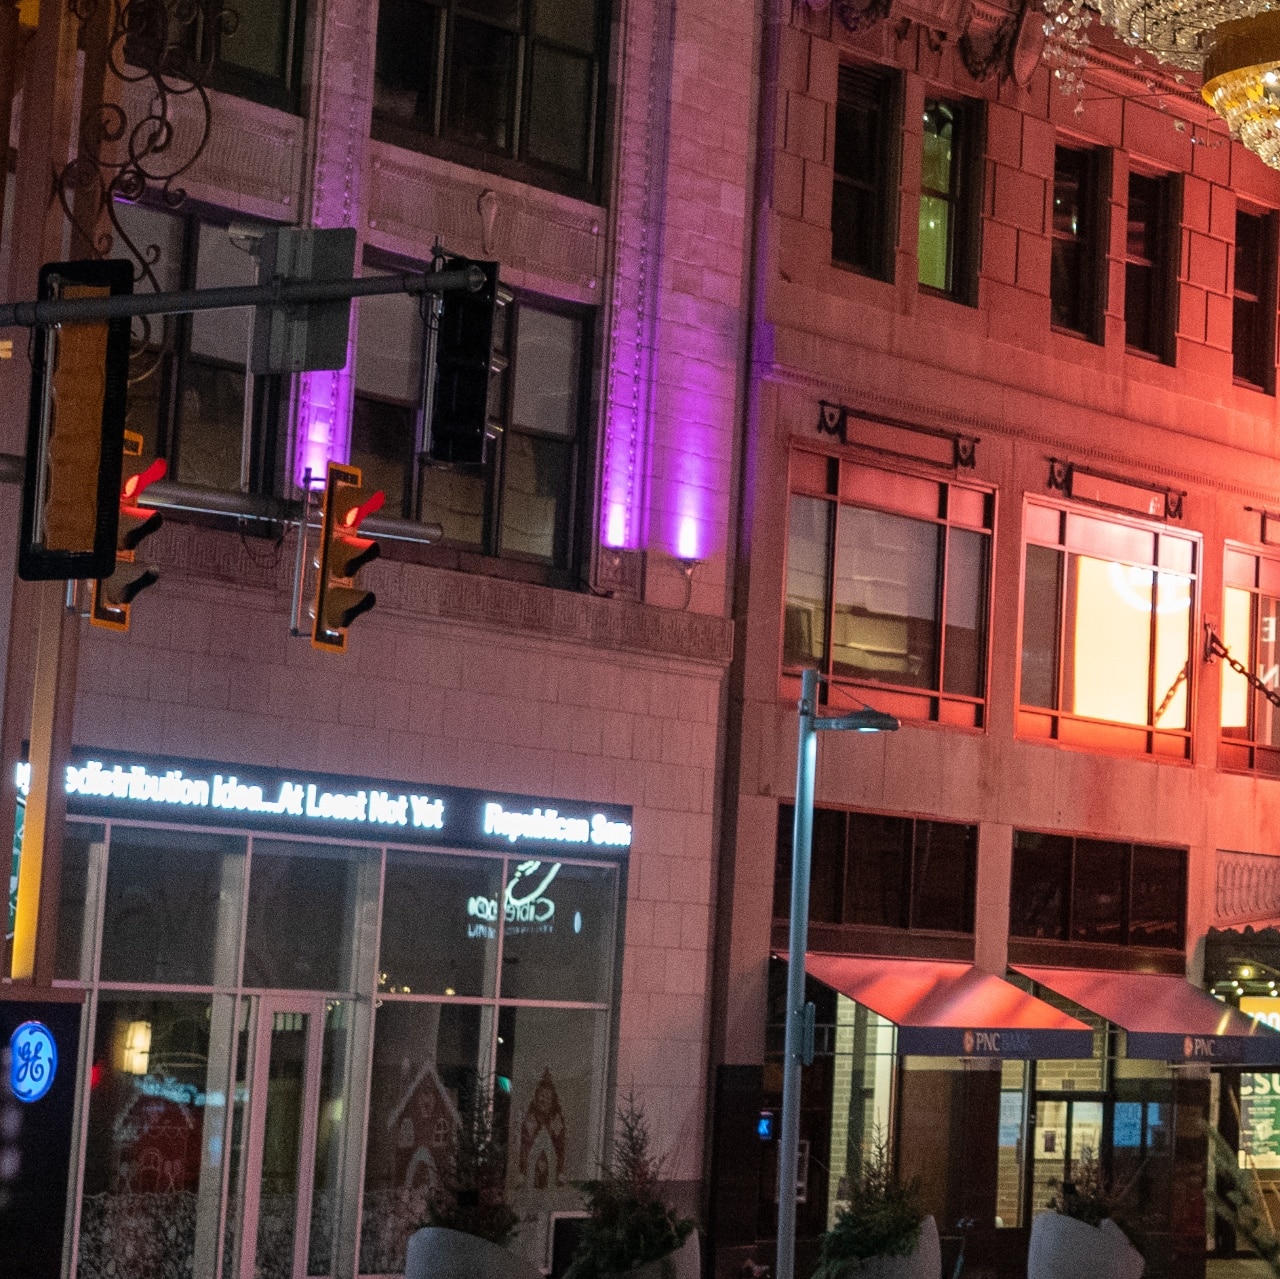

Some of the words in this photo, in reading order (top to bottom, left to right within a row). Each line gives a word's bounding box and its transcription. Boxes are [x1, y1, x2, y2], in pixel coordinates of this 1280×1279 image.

[369, 790, 407, 825] Not
[484, 801, 589, 842] Republican
[976, 1032, 1000, 1052] PNC
[1194, 1037, 1215, 1057] PNC
